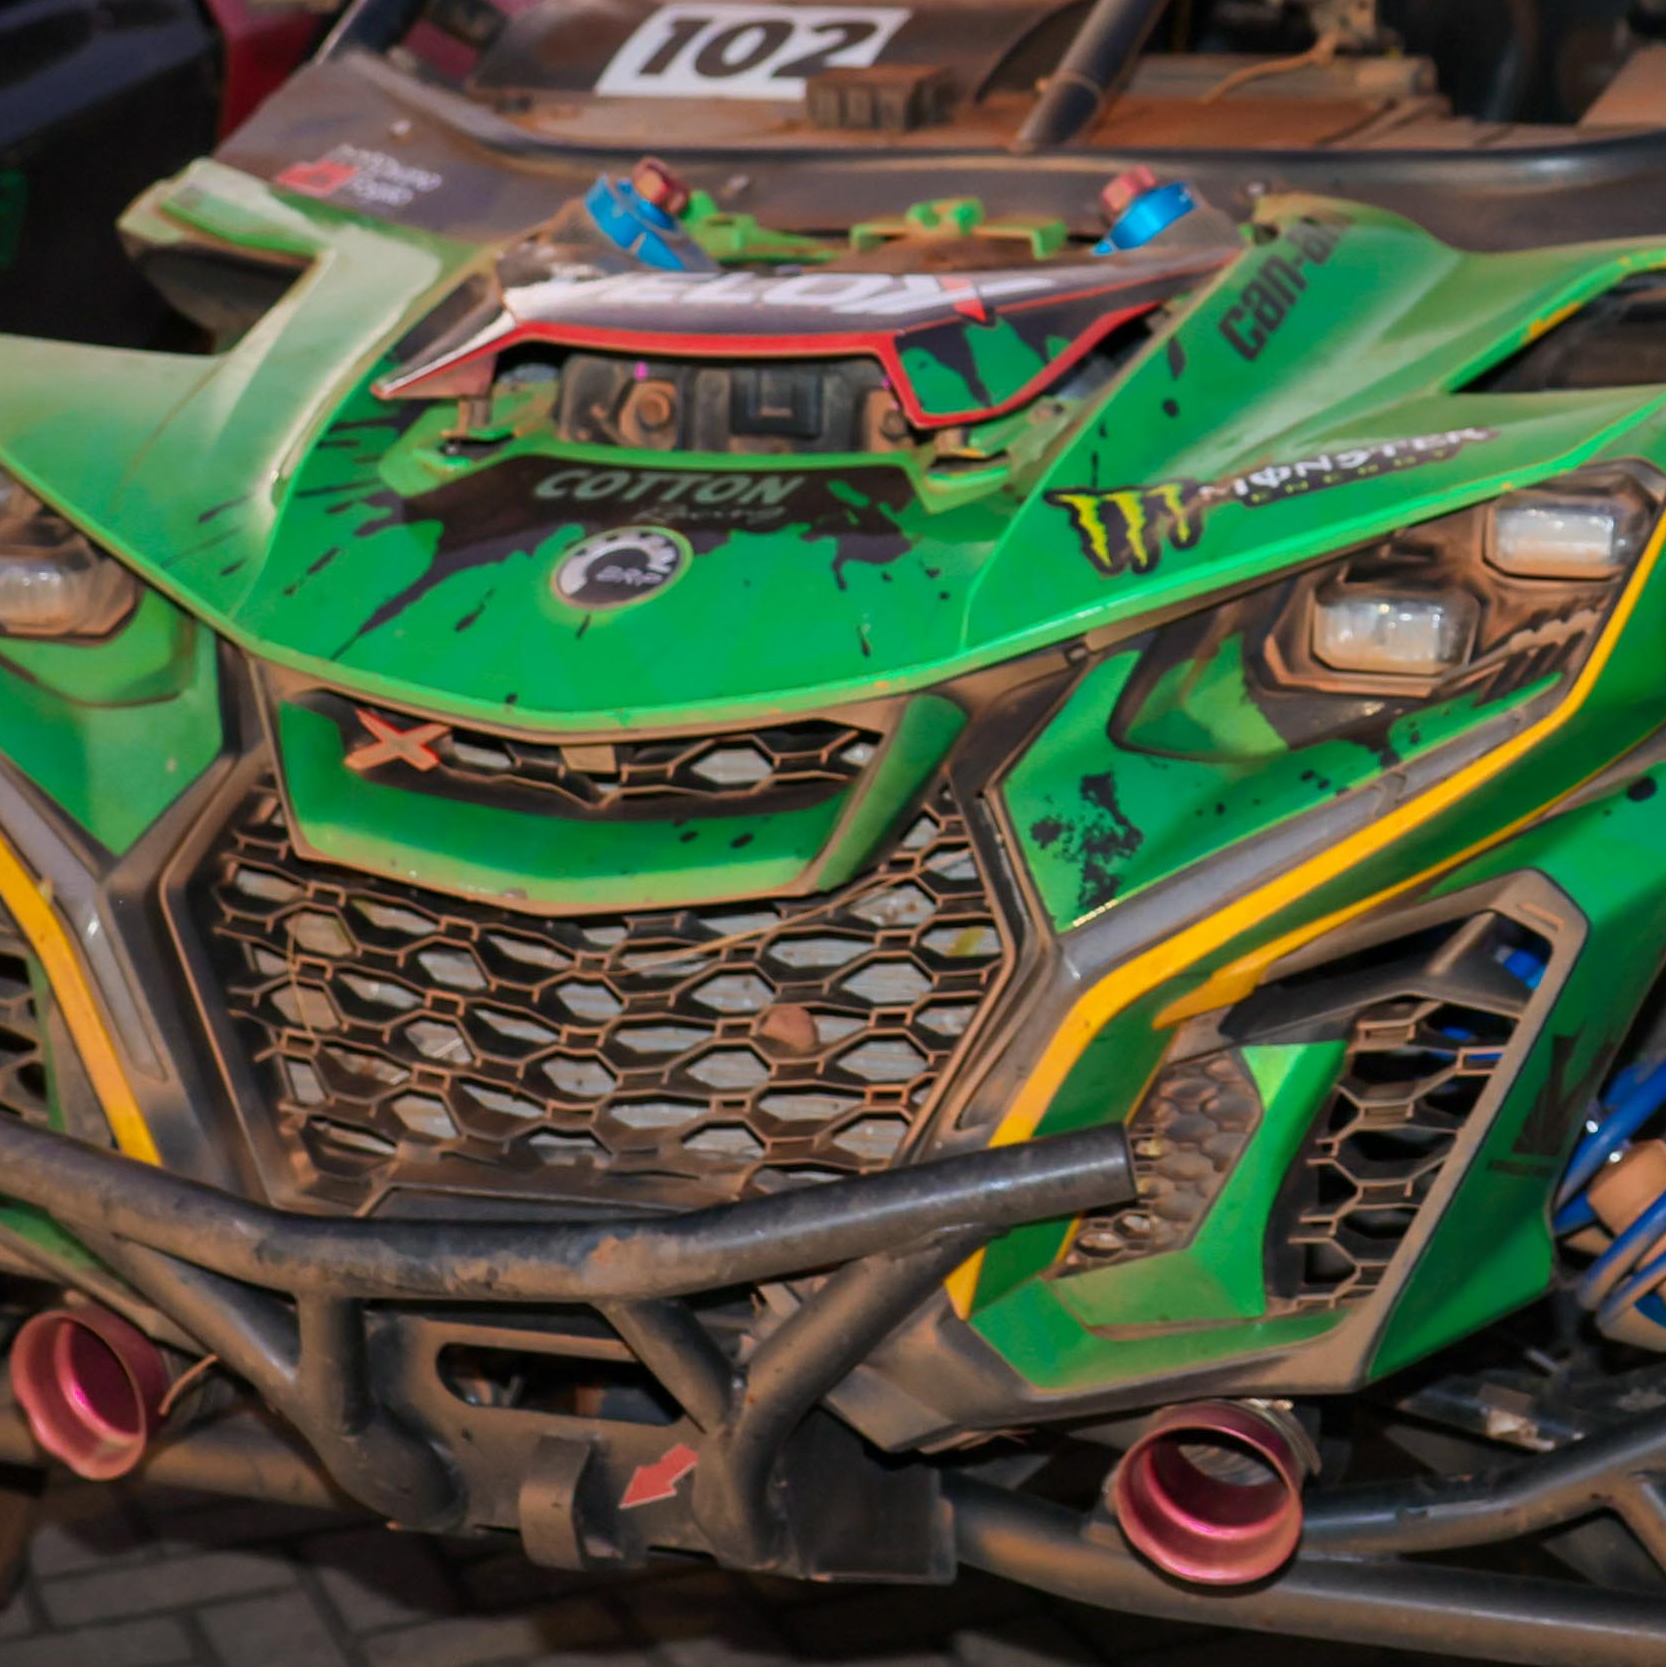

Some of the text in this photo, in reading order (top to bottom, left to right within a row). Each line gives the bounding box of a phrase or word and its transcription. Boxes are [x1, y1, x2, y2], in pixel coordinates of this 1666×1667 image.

[636, 17, 879, 81] 102
[535, 469, 805, 505] COTTON
[595, 563, 664, 587] BRP
